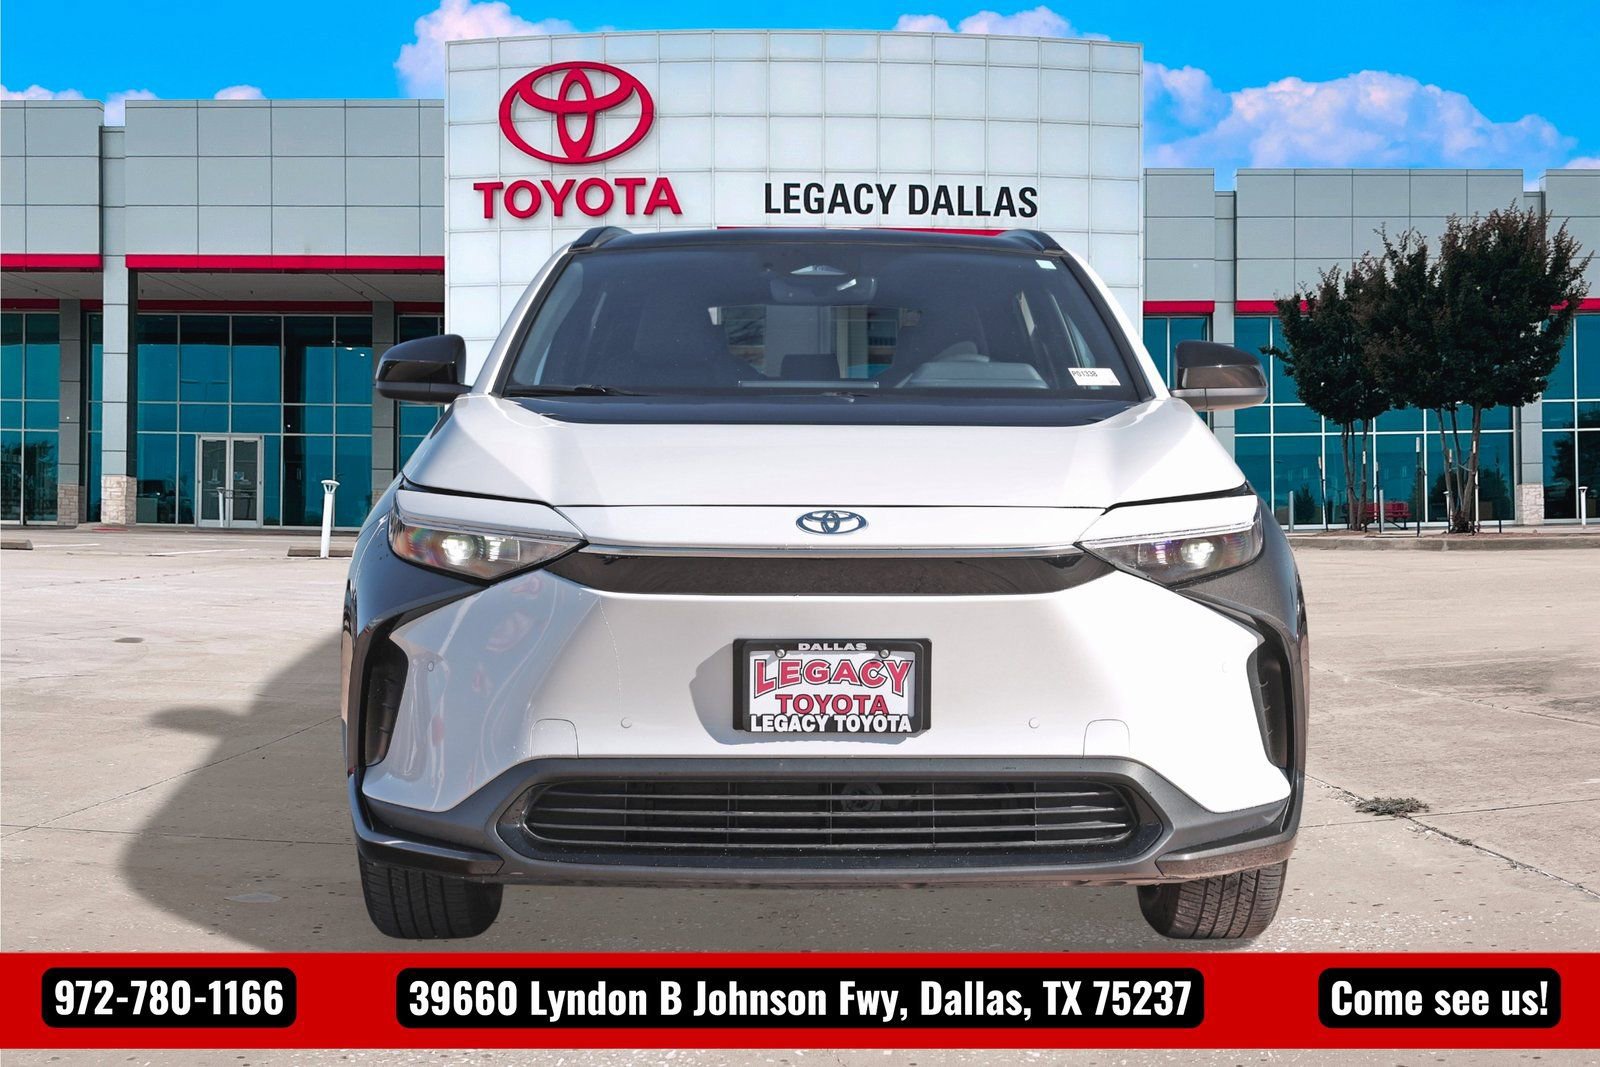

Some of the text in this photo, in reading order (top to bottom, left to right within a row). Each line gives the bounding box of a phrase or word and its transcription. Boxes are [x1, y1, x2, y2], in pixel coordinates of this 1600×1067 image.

[473, 177, 682, 219] TOYOTA
[764, 183, 1039, 218] LEGACY DALLAS
[798, 643, 867, 651] DALLAS
[753, 658, 914, 699] LEGACY
[775, 694, 889, 716] TOYOTA
[750, 714, 912, 733] LEGACY TOYOTA
